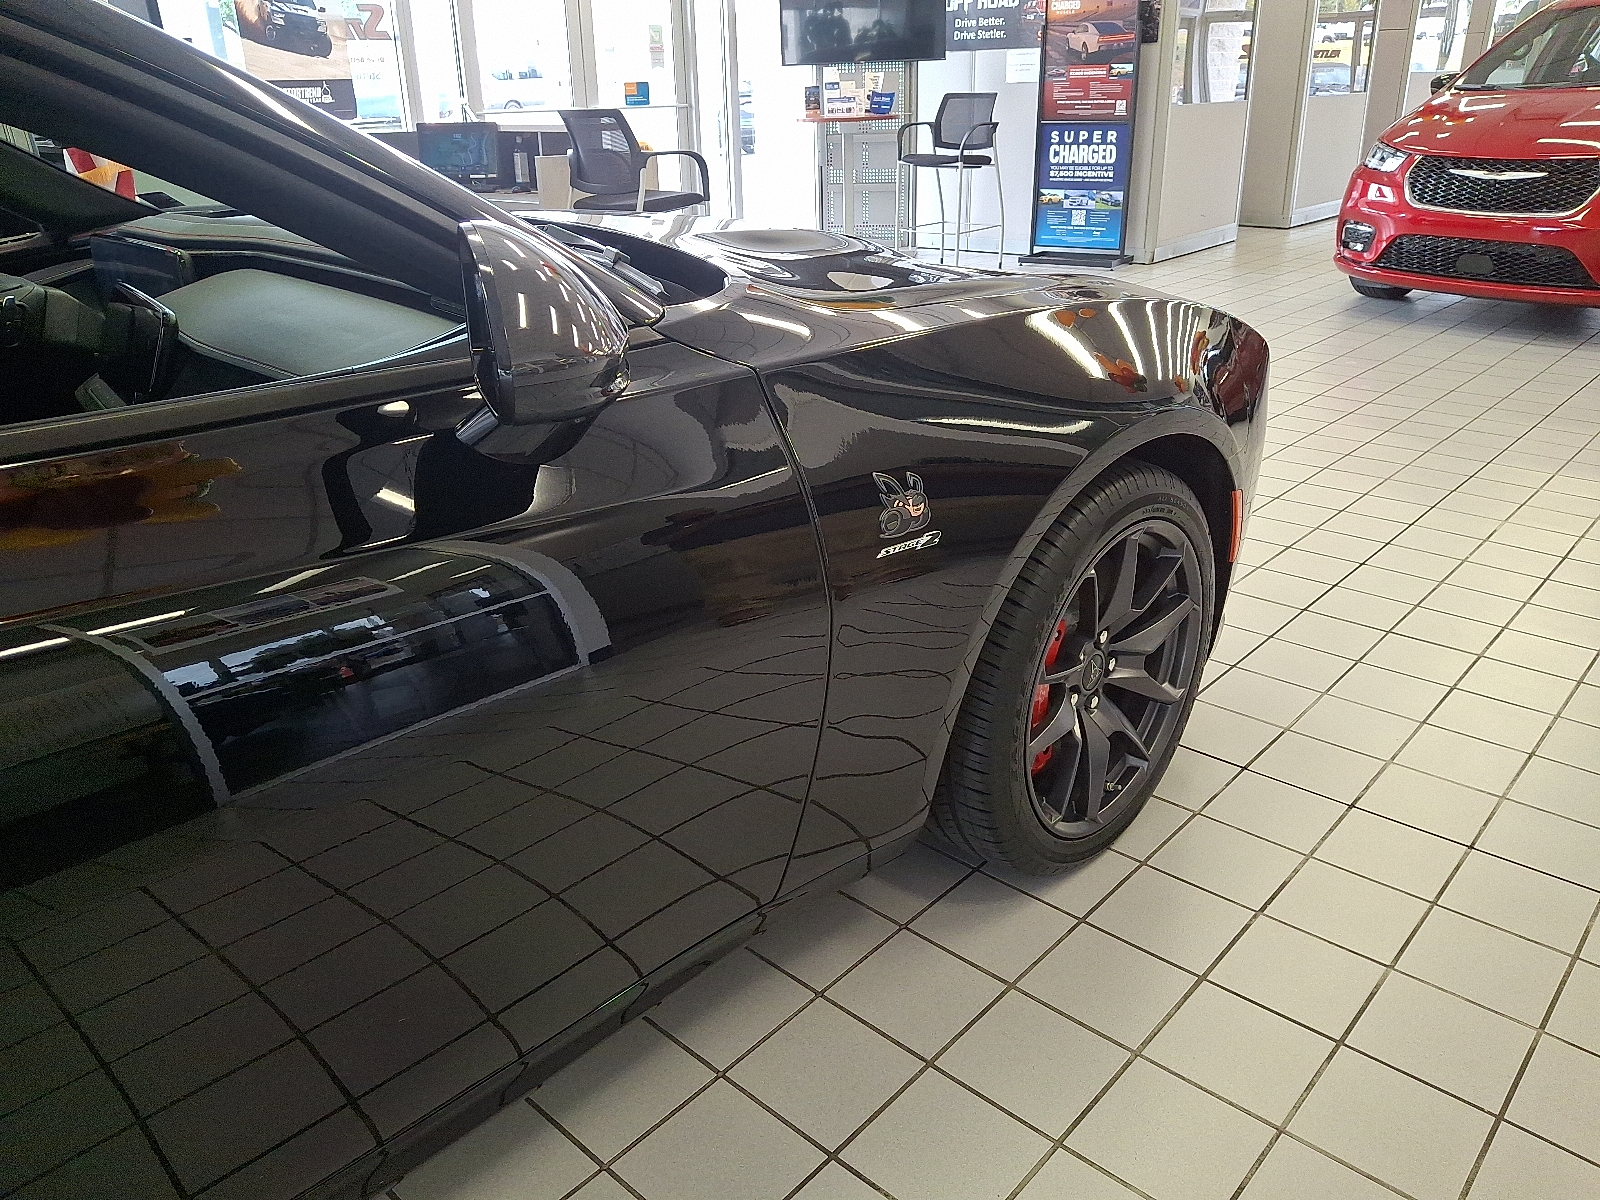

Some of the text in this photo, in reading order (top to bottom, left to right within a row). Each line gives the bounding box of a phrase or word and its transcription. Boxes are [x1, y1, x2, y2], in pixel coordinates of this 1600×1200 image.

[955, 16, 1006, 28] Drive Better.
[953, 28, 1007, 40] Drive Stetler.
[281, 86, 321, 99] OTORTREND
[1050, 131, 1118, 143] SUPER
[1049, 144, 1117, 163] CHARGED
